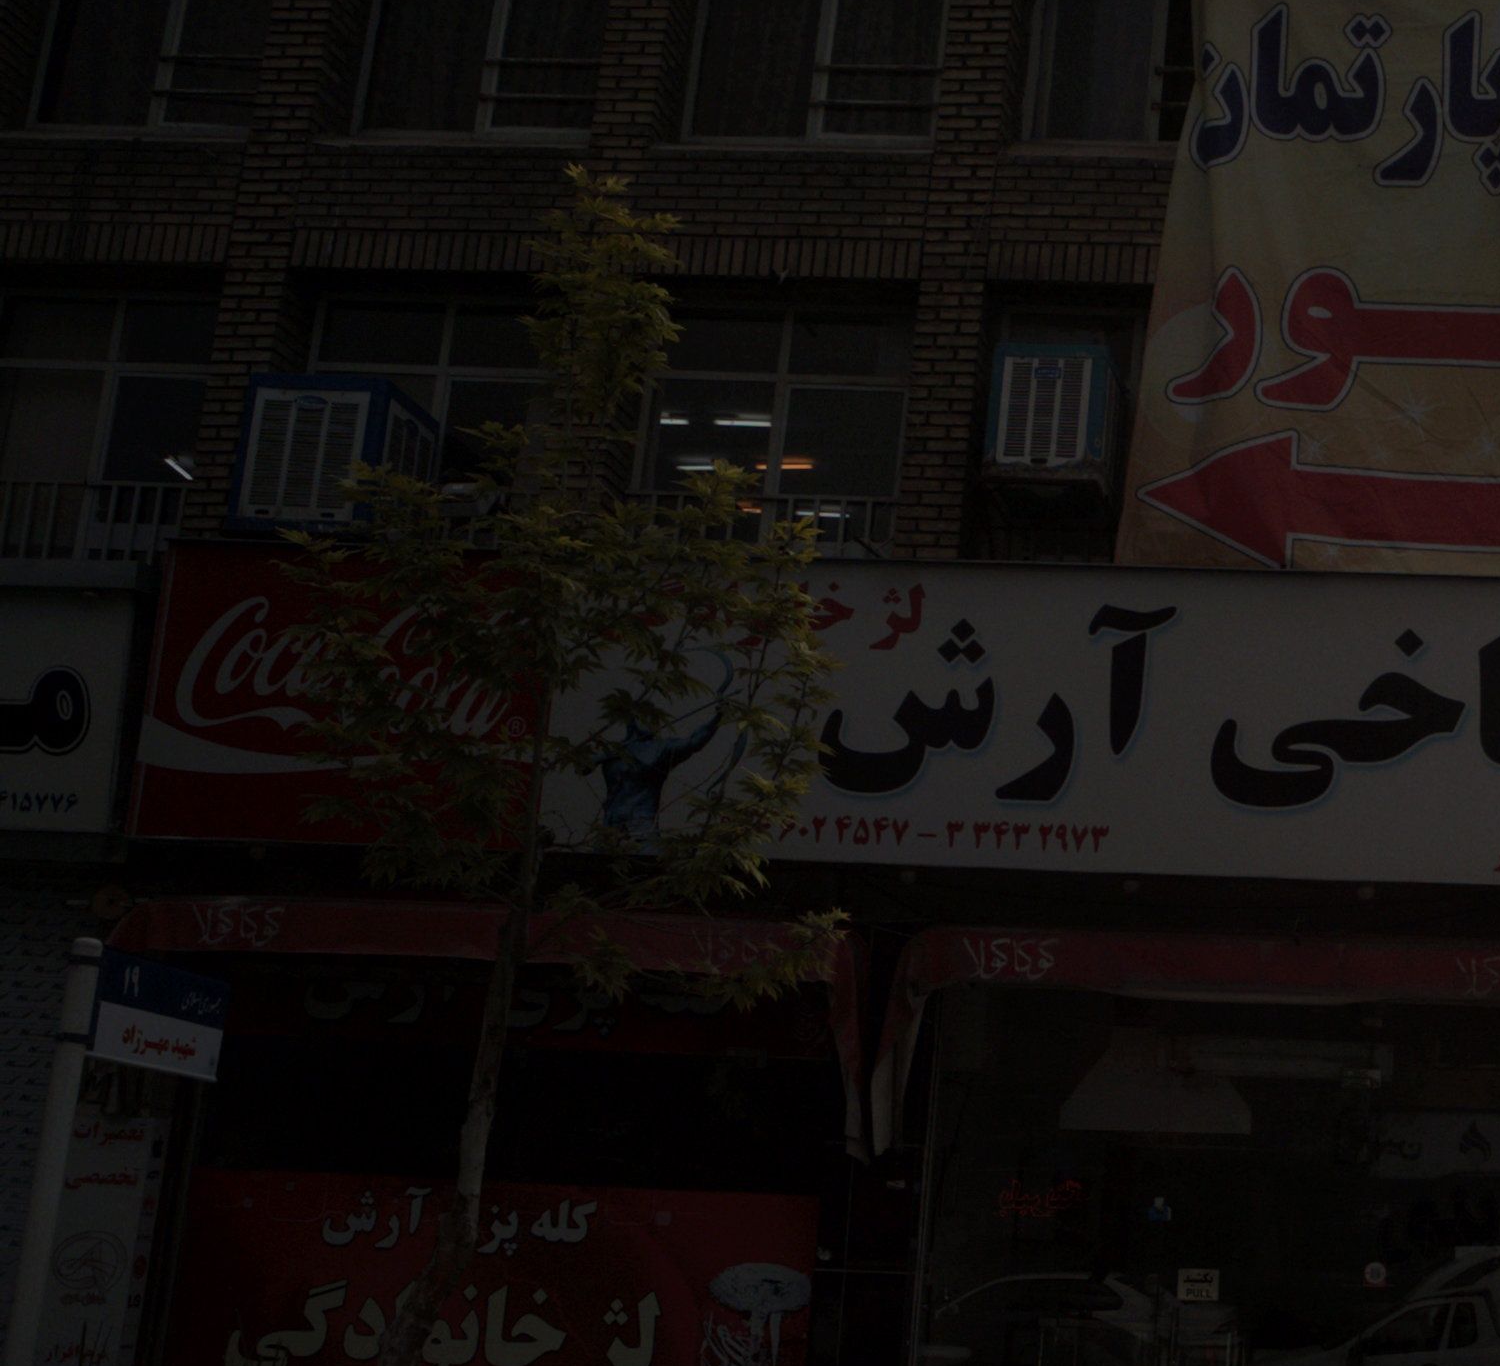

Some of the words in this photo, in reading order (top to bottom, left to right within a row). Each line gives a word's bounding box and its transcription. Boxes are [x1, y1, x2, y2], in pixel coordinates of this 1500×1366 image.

[869, 582, 926, 651] لژ
[817, 603, 1177, 803] آرش
[320, 1185, 433, 1249] آرش
[529, 1197, 598, 1244] کله
